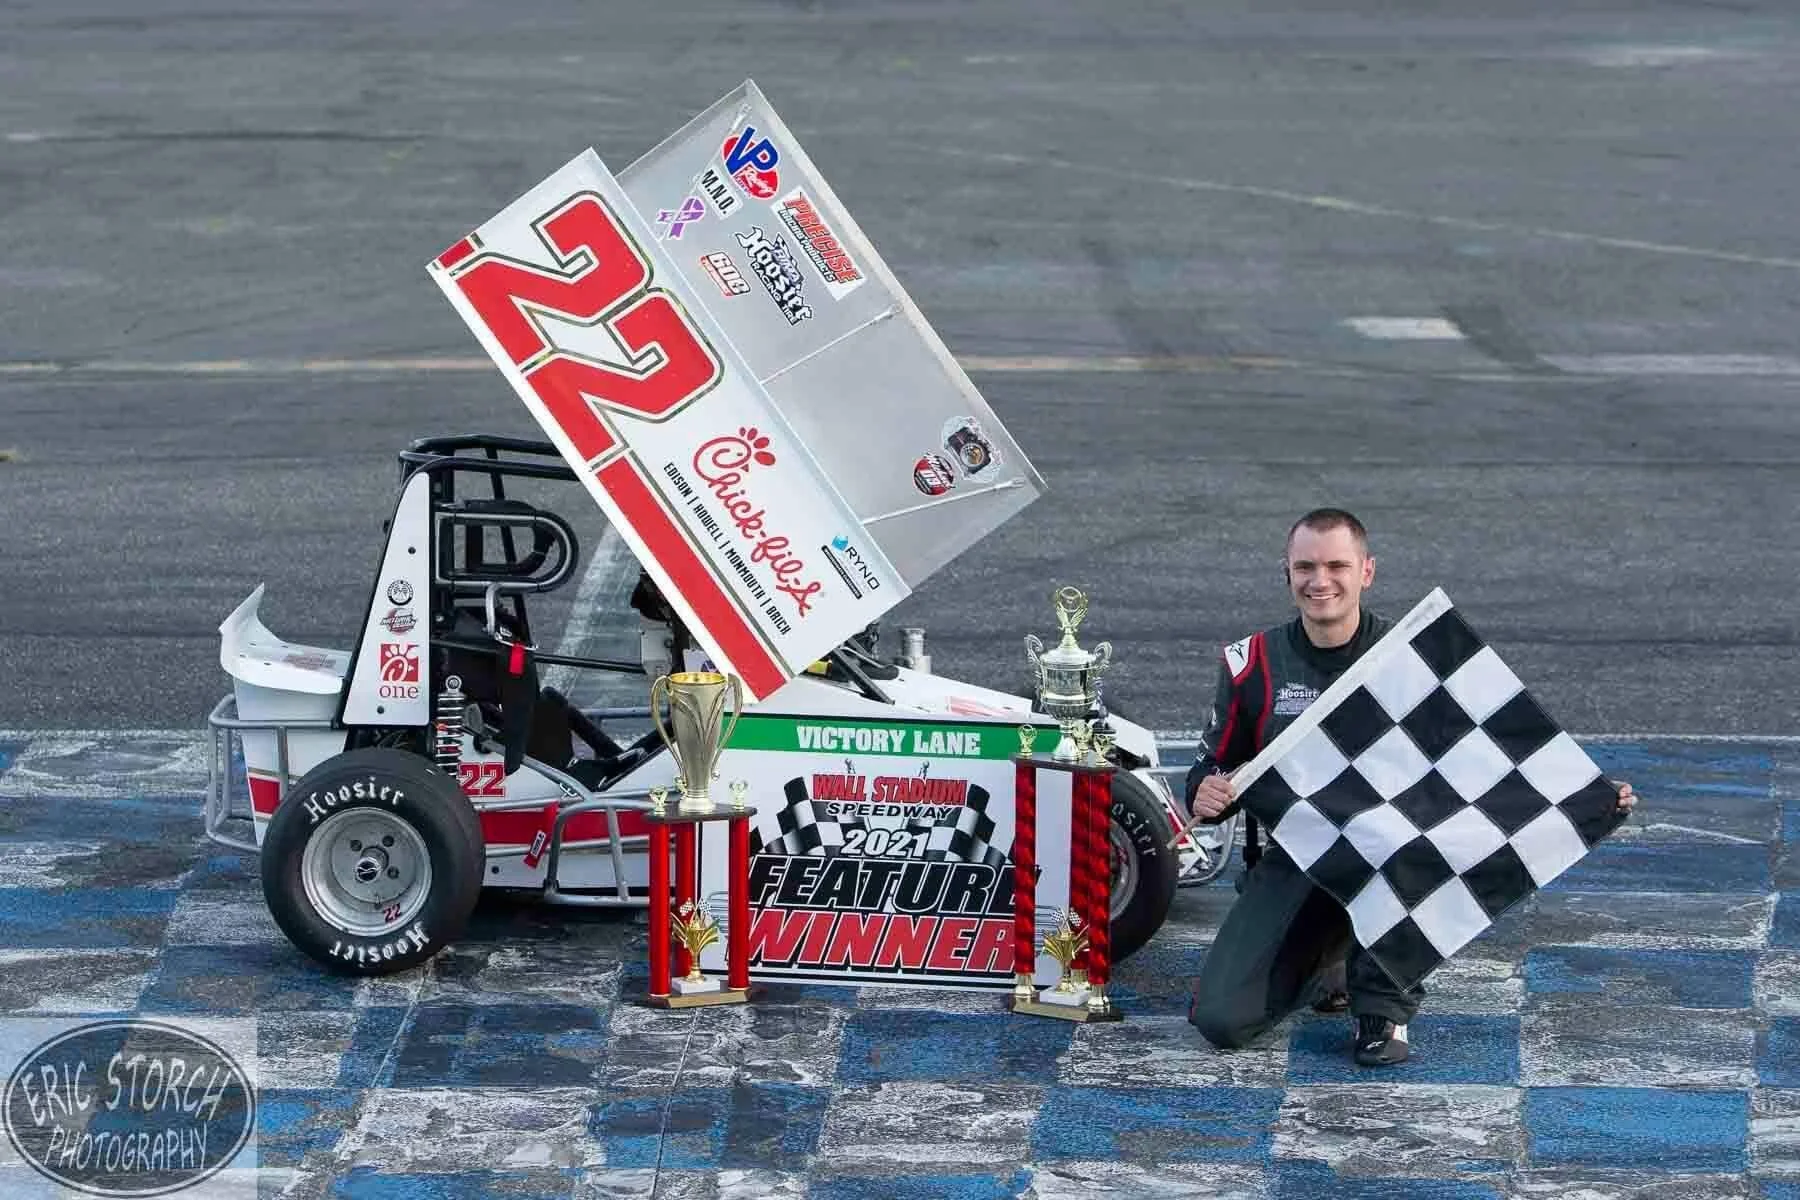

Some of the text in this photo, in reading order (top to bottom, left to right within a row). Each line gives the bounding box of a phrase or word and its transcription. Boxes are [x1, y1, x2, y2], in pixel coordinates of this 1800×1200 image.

[725, 126, 779, 176] VP
[701, 169, 734, 215] M.N.O.
[780, 193, 864, 285] PRECISE
[735, 226, 813, 322] Hoosier
[750, 262, 782, 305] RACING
[449, 189, 725, 473] 22
[663, 461, 693, 500] EDISON
[692, 503, 724, 543] HOWELL
[724, 546, 766, 601] MONMOUTH
[692, 426, 824, 618] Chick-fil-A
[844, 546, 881, 591] RYNO
[379, 685, 419, 699] one
[797, 726, 981, 755] VICTORY LANE
[303, 776, 405, 824] Hoosier
[459, 762, 505, 797] 22
[812, 774, 968, 805] WALL STADIUM
[828, 803, 951, 819] SPEEDWAY
[840, 829, 930, 858] 2021
[328, 921, 430, 968] Hoosier
[749, 908, 1016, 974] WINNER
